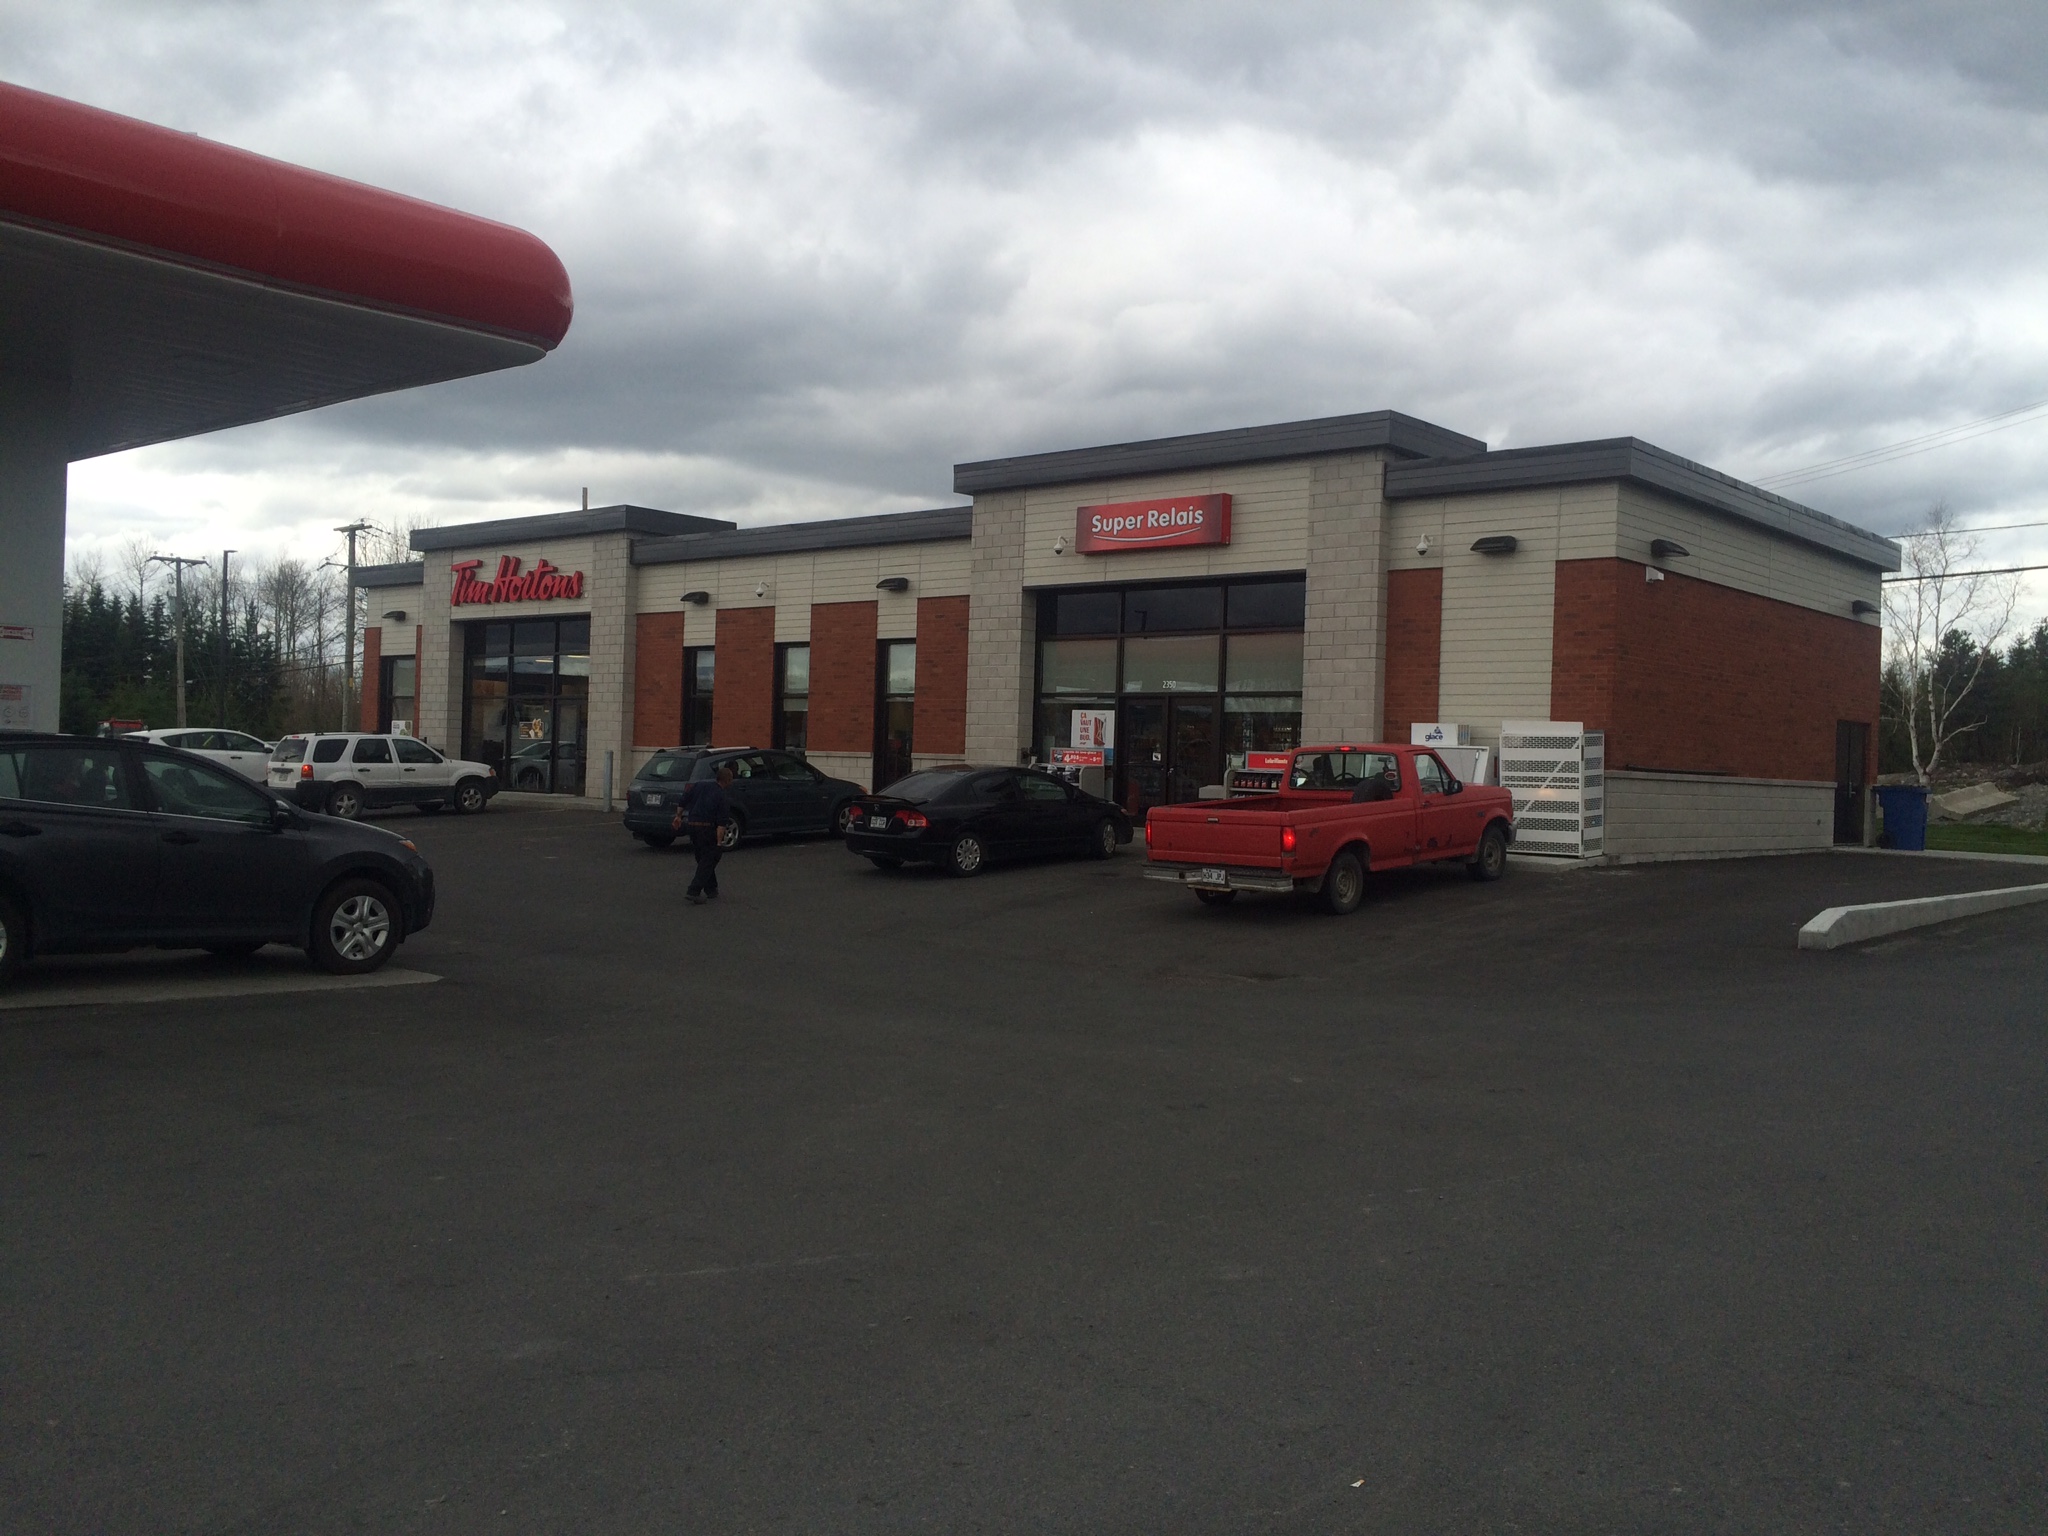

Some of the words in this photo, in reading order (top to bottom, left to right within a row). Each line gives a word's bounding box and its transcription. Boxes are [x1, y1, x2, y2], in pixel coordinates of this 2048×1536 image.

[1091, 514, 1144, 536] Super
[1147, 505, 1204, 528] Relais
[451, 559, 493, 607] Tim
[491, 554, 583, 602] Hortons
[1162, 680, 1177, 689] 2350
[1080, 726, 1090, 734] UNE
[1424, 732, 1444, 742] glace
